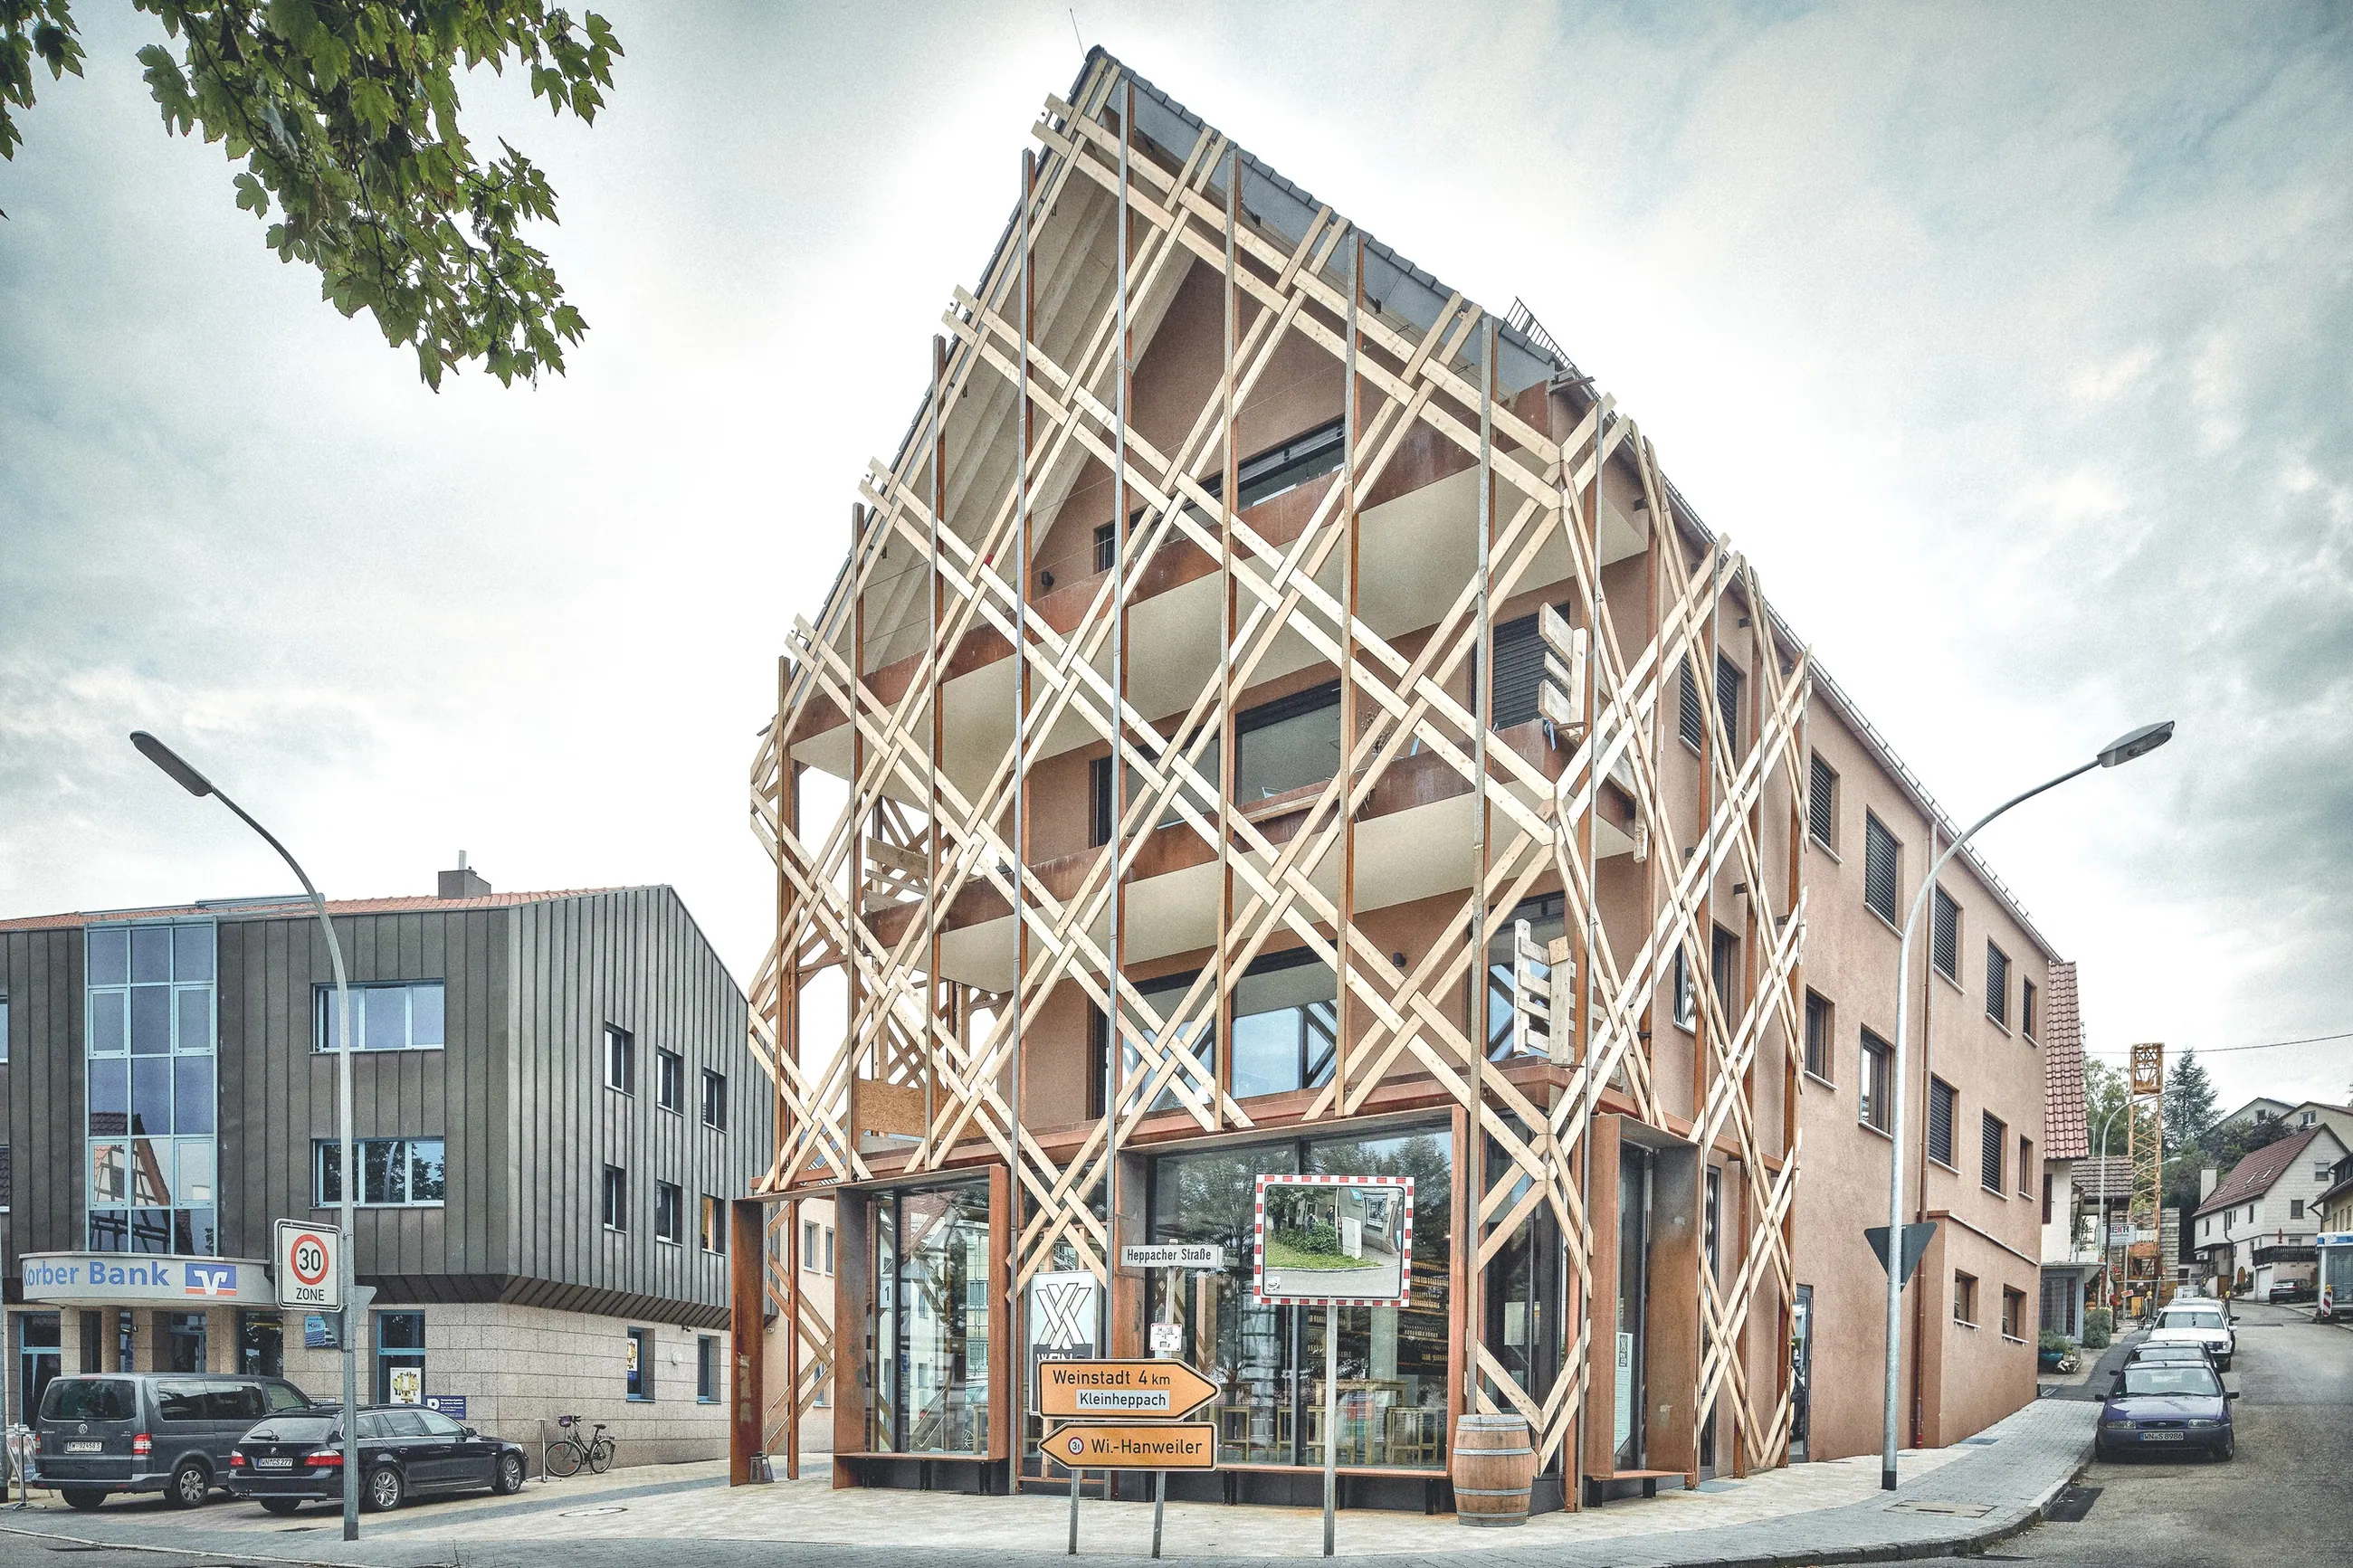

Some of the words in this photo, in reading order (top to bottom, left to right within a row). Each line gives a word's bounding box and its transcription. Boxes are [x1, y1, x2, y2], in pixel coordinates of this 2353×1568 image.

[299, 1248, 321, 1271] 30
[1127, 1249, 1176, 1264] Heppacher
[1181, 1248, 1212, 1260] Straße
[24, 1261, 80, 1287] Korber
[89, 1260, 170, 1287] Bank
[296, 1288, 325, 1301] ZONE
[884, 1286, 890, 1301] 1
[1053, 1369, 1130, 1385] Weinstadt
[1138, 1370, 1148, 1384] 4
[1152, 1373, 1170, 1385] km
[1080, 1392, 1167, 1409] Kleinheppach
[1091, 1439, 1203, 1454] Wi.-Hanweiler
